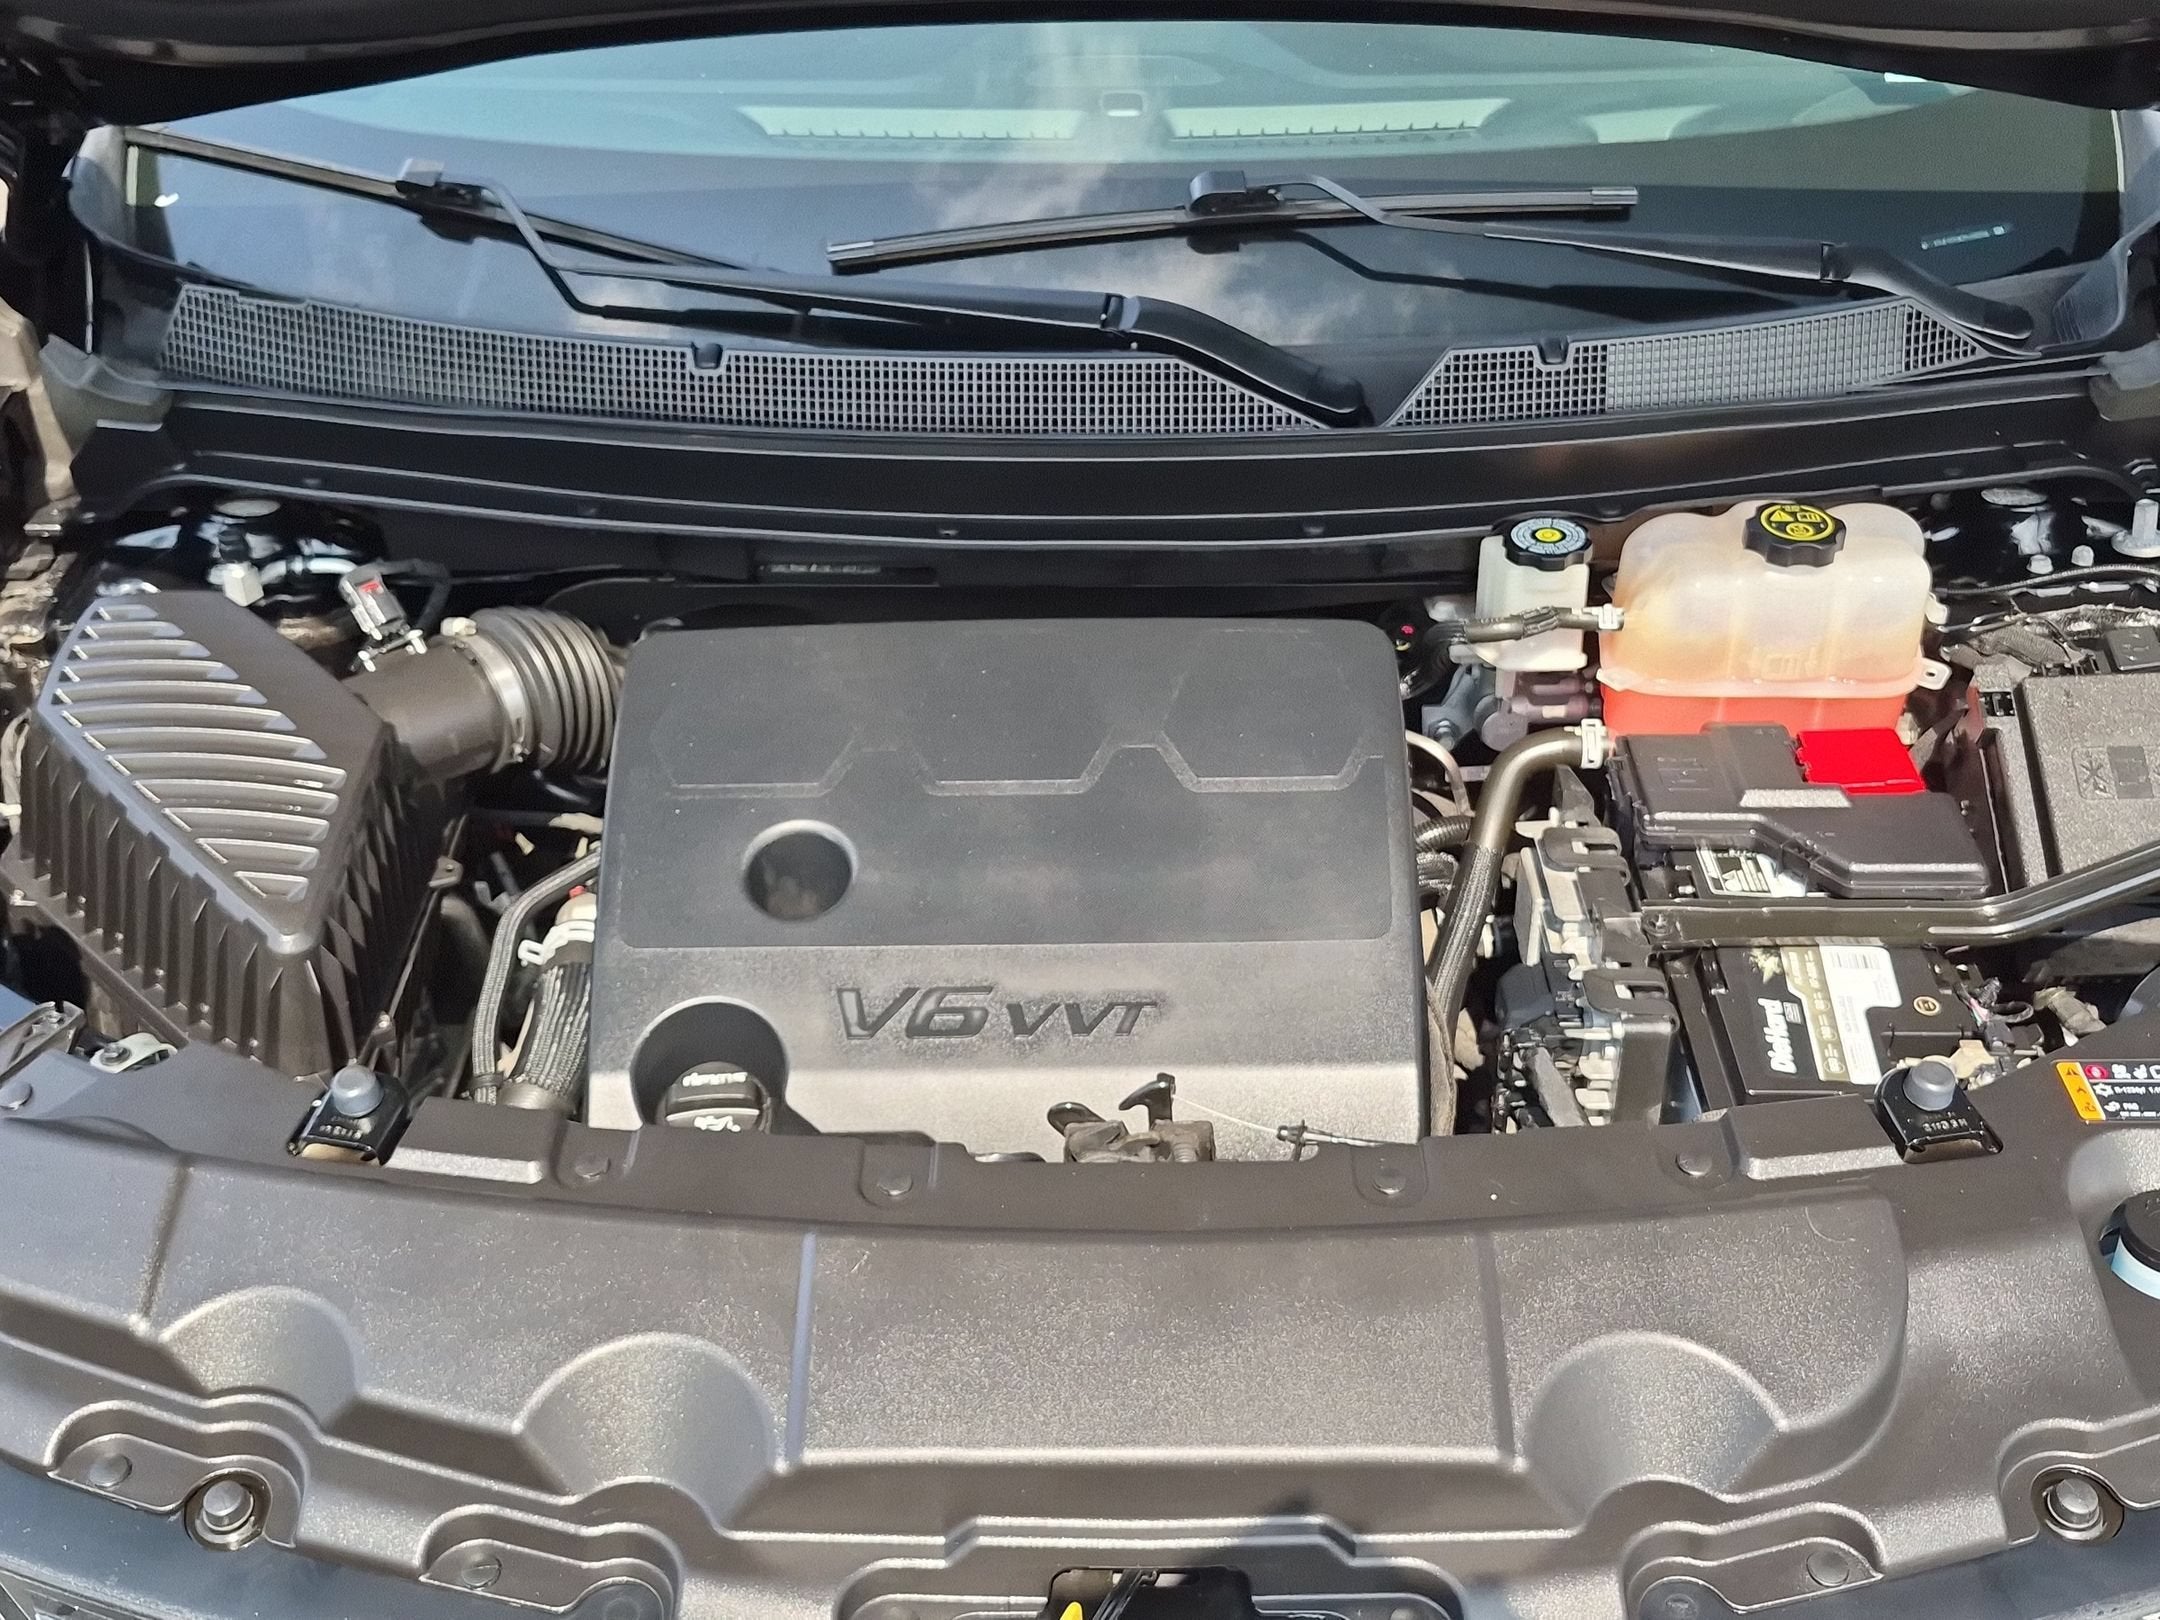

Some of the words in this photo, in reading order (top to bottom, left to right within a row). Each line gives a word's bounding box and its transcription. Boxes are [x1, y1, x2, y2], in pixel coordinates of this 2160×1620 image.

[837, 987, 993, 1039] V6
[1006, 1001, 1157, 1037] VVT
[1757, 998, 1797, 1074] DieHard
